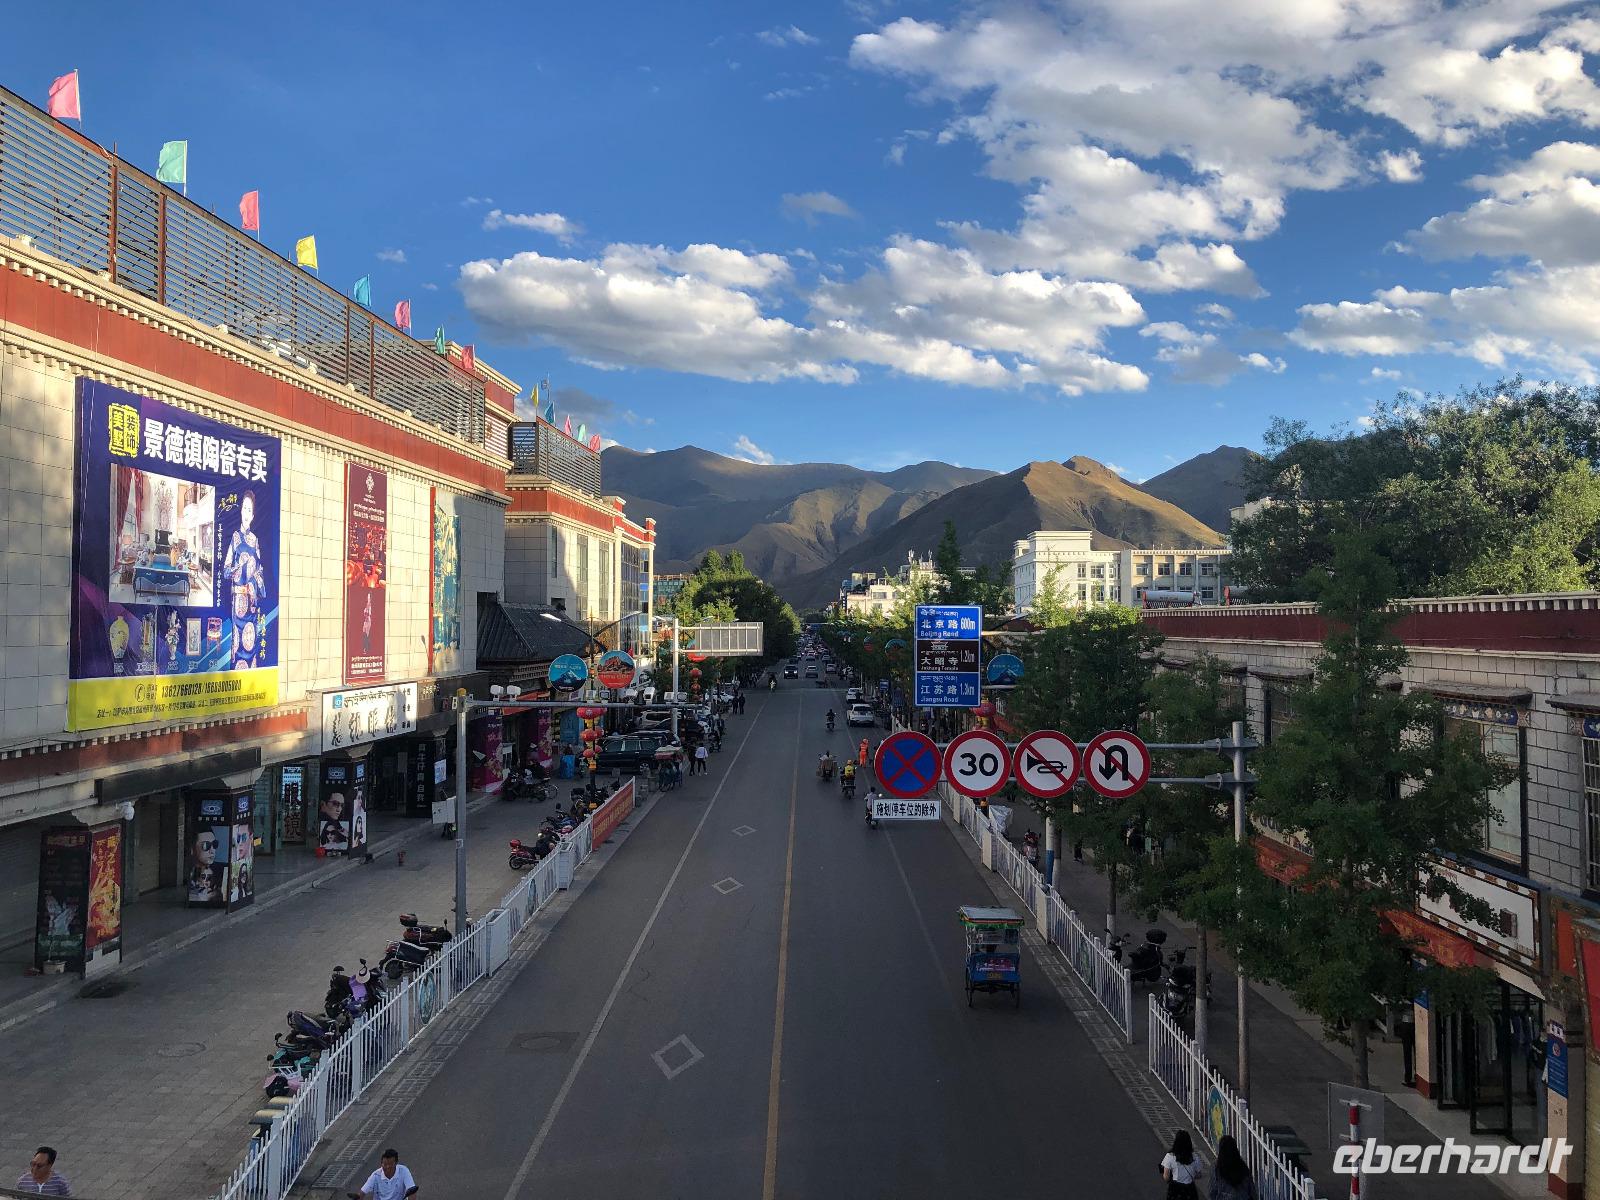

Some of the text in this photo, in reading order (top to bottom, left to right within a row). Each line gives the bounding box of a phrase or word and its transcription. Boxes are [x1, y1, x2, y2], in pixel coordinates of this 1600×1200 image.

[144, 418, 267, 483] 景德镇陶瓷专卖
[920, 616, 976, 630] 北京路 600m
[920, 630, 942, 638] Beijing
[920, 656, 959, 666] 大昭寺
[920, 682, 975, 696] 江苏路 1.3km
[958, 752, 999, 777] 30
[876, 802, 937, 817] 施划停车位的除外
